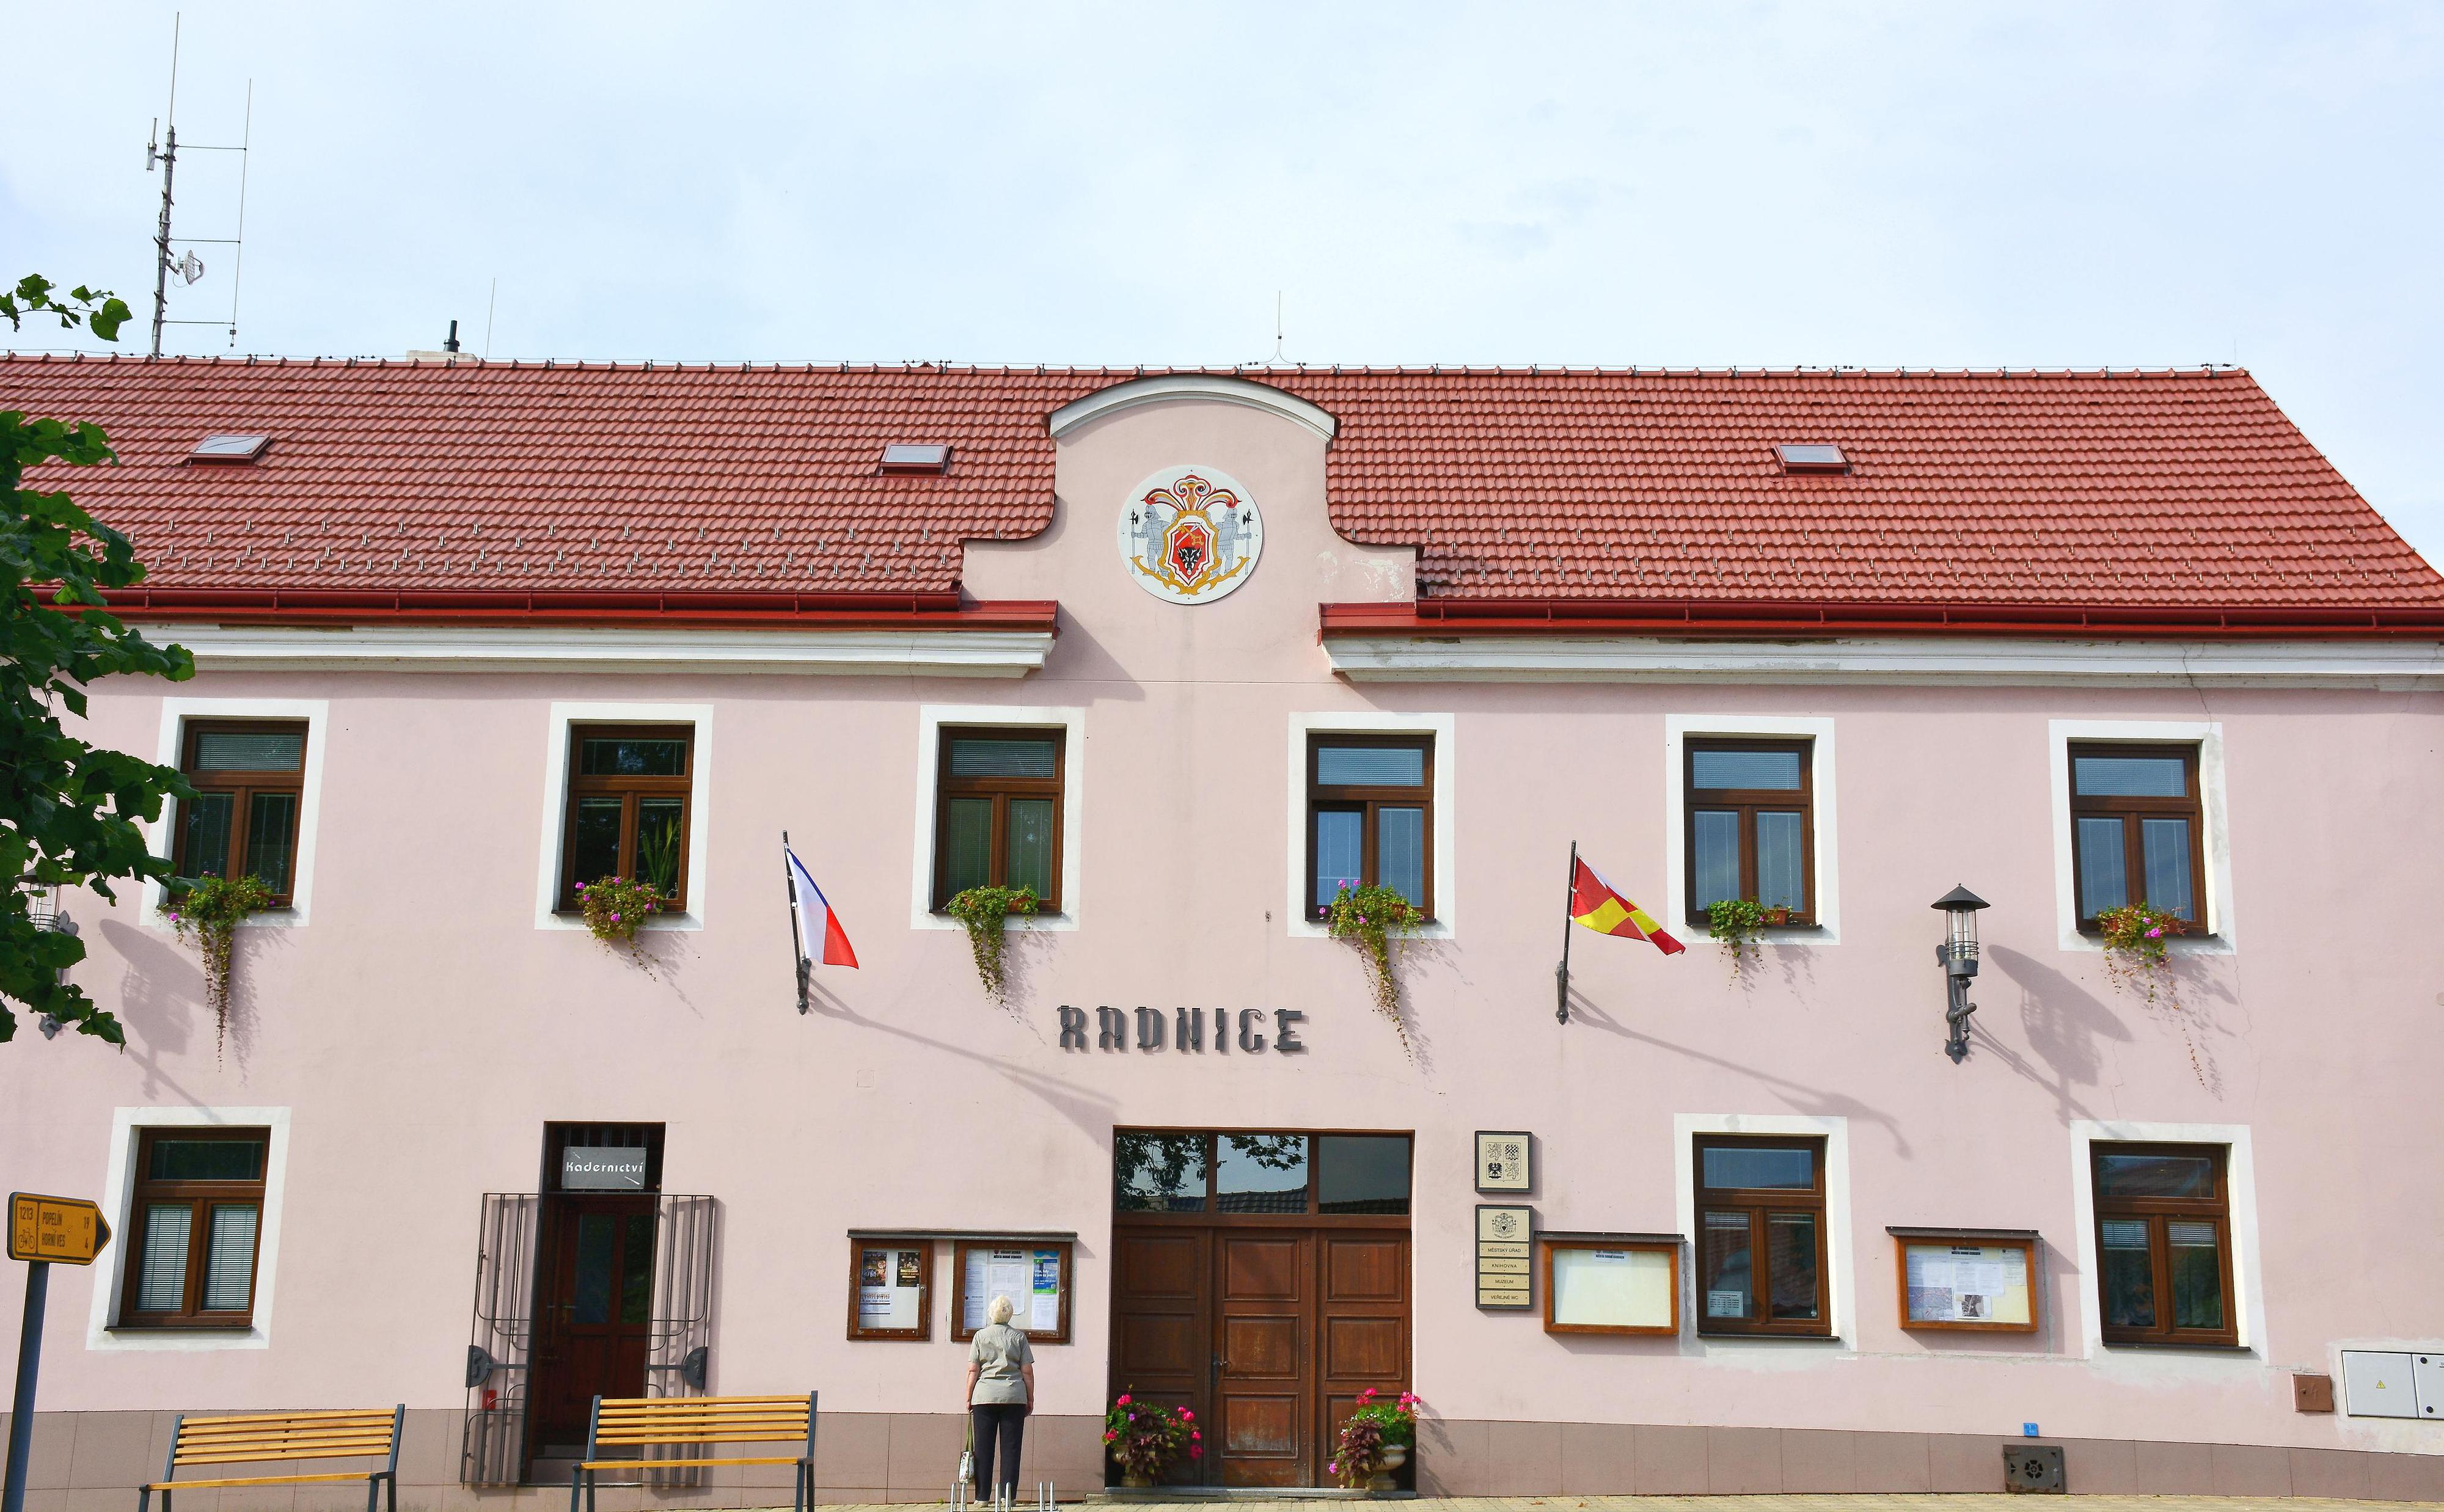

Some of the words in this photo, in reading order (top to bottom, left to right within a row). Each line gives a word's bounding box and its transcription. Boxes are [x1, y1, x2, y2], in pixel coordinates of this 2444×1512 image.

[1057, 1005, 1302, 1051] RADNICE
[20, 1207, 34, 1221] 1213
[42, 1210, 62, 1226] POPELÍN
[42, 1230, 56, 1247] HORNÍ
[56, 1233, 66, 1247] VES
